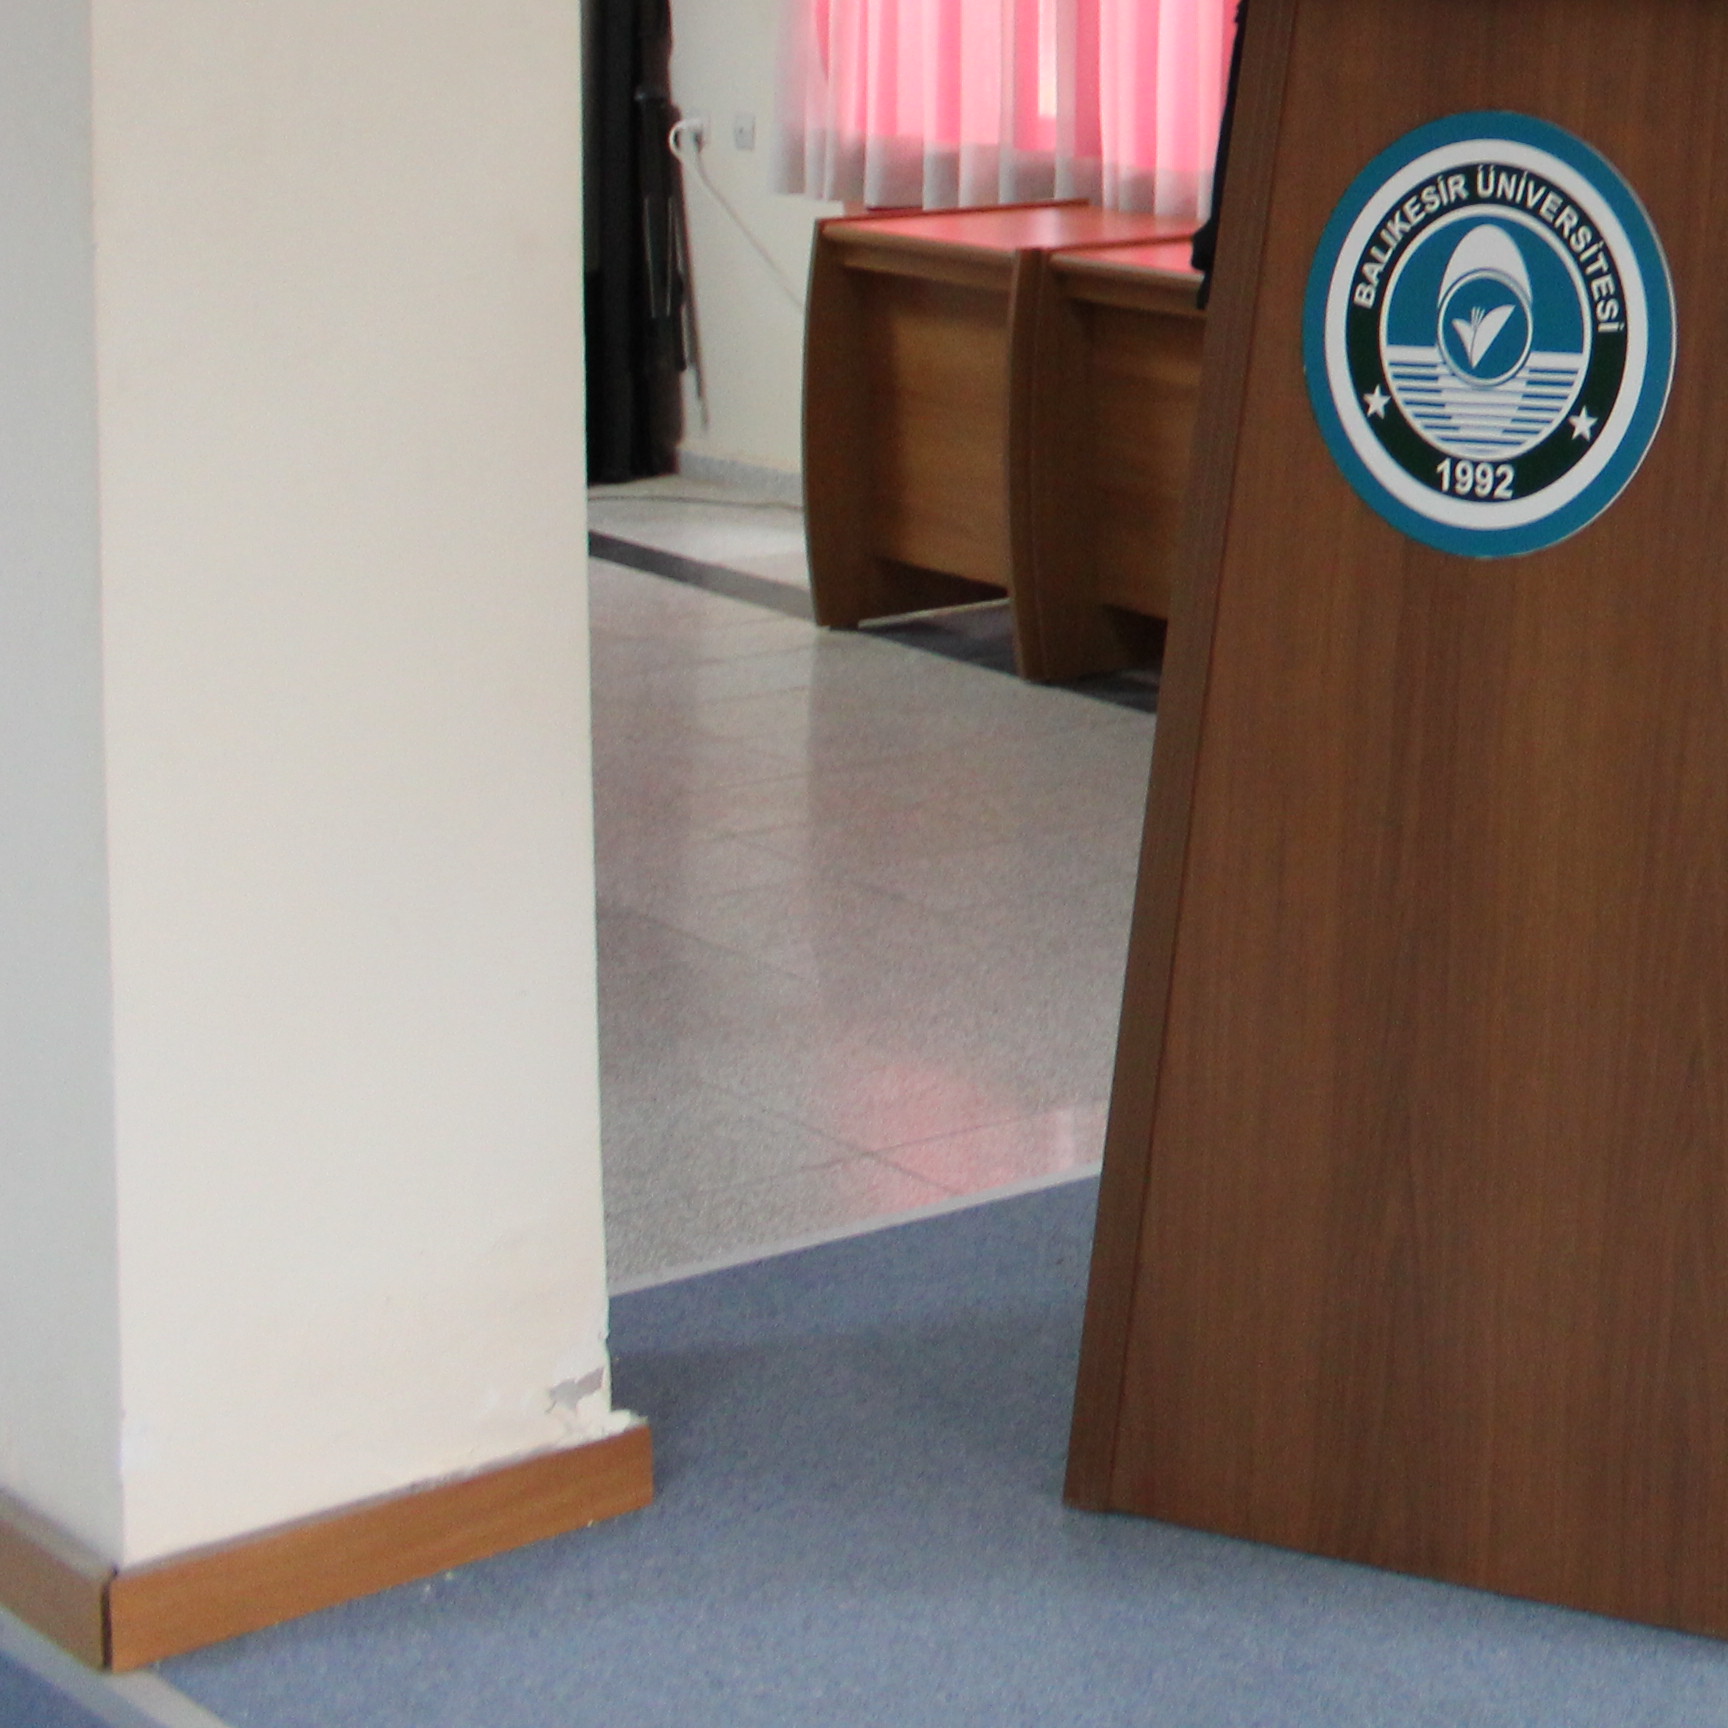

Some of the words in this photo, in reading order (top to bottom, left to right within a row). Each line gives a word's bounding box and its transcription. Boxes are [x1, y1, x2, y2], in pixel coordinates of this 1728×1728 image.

[1354, 173, 1470, 309] BALIKESİR
[1476, 164, 1626, 334] ÜNİVERSİTESİ
[1436, 457, 1516, 500] 1992
